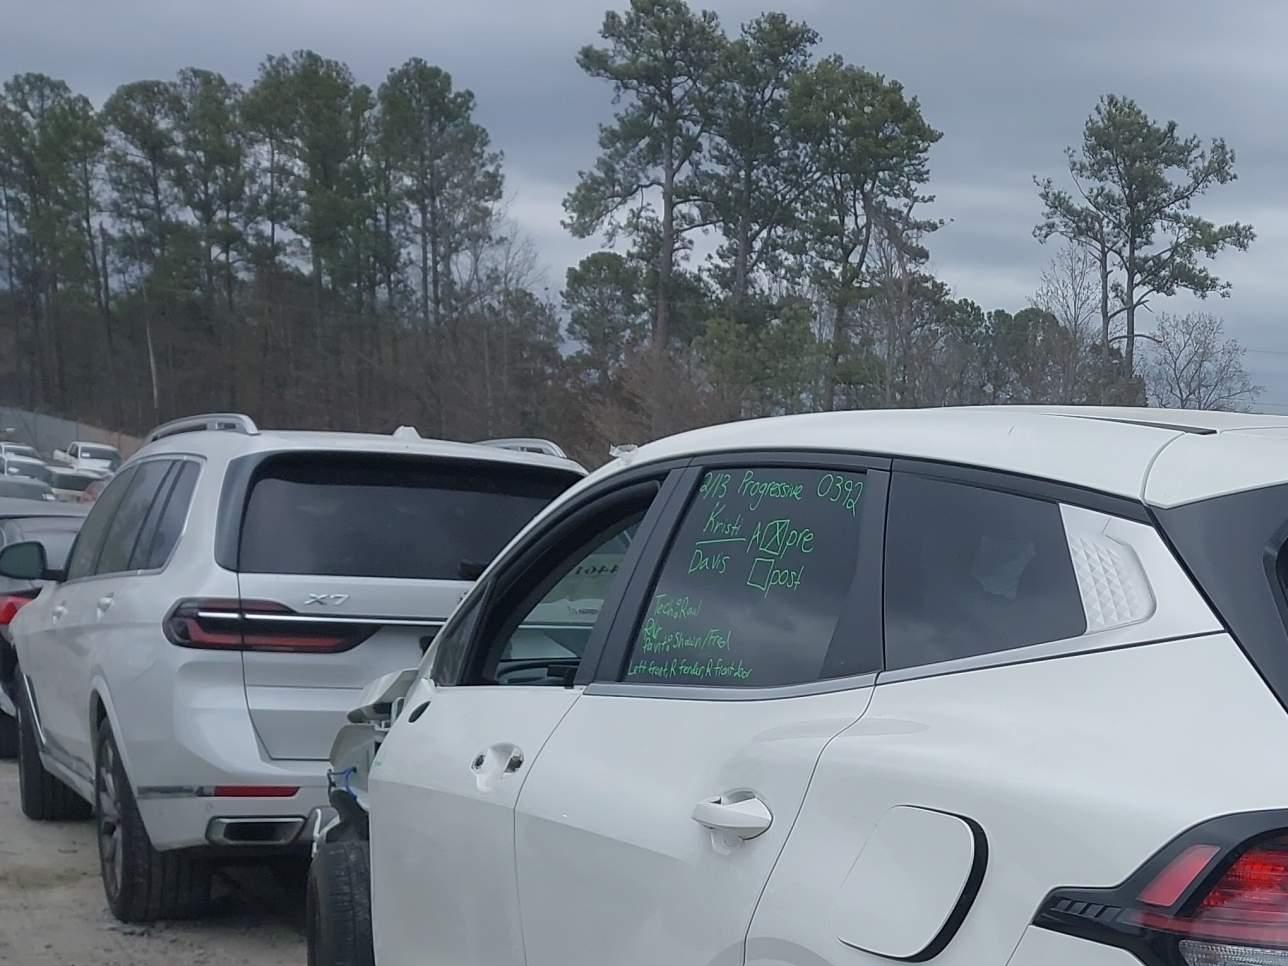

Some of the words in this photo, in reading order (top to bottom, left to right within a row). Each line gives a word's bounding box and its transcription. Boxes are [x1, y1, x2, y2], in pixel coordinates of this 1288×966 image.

[700, 471, 731, 499] 2/13
[738, 470, 803, 511] Progressive
[817, 473, 864, 518] 0392
[703, 502, 744, 536] Kristi
[688, 549, 730, 574] Davis
[304, 592, 350, 606] X7
[765, 565, 805, 600] post
